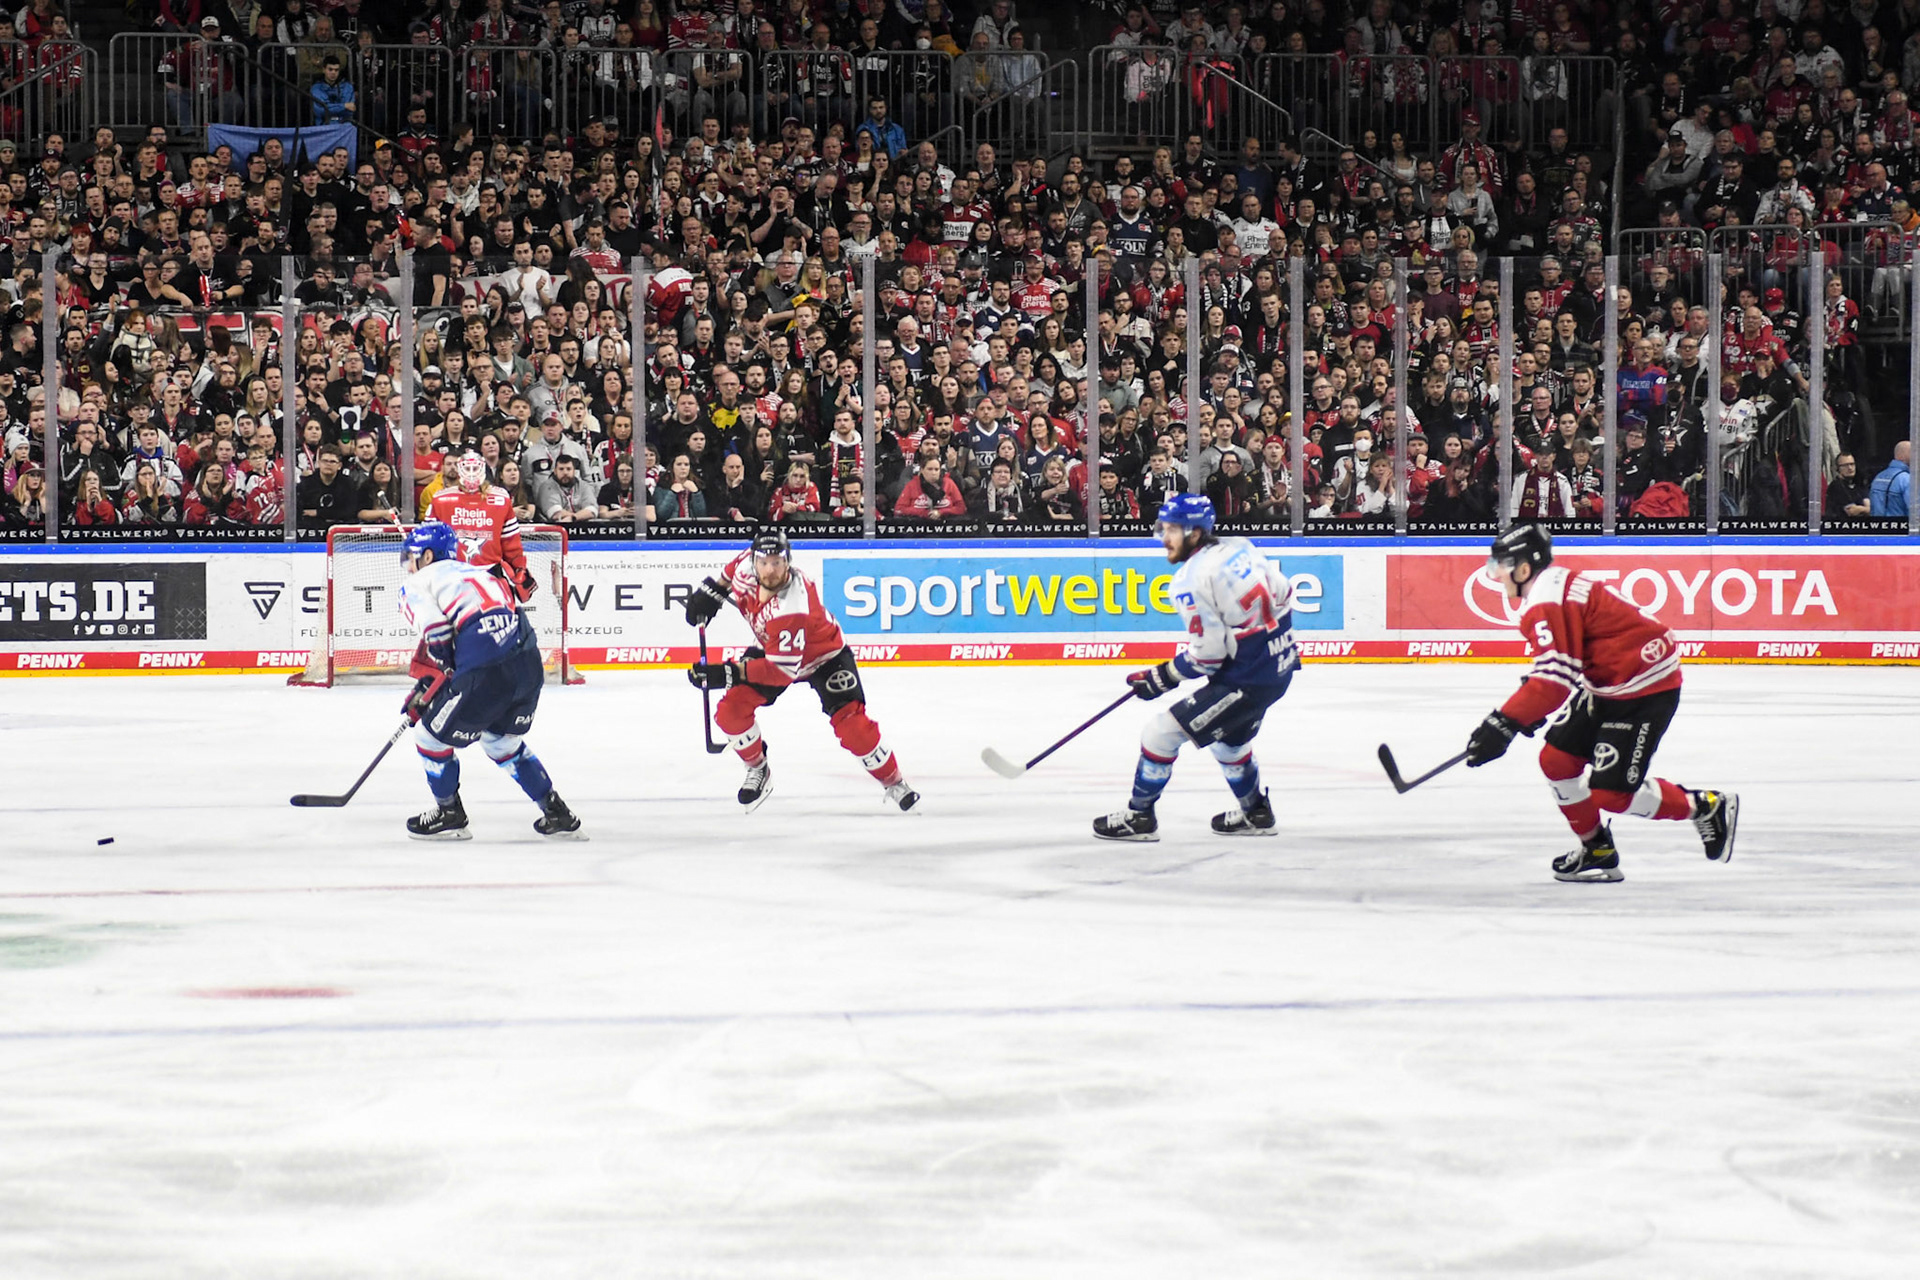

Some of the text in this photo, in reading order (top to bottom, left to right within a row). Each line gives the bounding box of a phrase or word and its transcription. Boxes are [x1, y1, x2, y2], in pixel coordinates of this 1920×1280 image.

[1023, 294, 1047, 303] Rhein
[454, 507, 487, 518] Rhein
[451, 516, 493, 527] Energie
[1307, 523, 1395, 531] STAHLWERK
[1409, 522, 1497, 530] STAHLWERK
[1618, 522, 1706, 530] STAHLWERK
[1722, 521, 1808, 529] STAHLWERK
[1823, 521, 1908, 529] STAHLWERK
[1189, 614, 1204, 638] 4
[1534, 620, 1554, 647] 5
[778, 628, 806, 652] 24
[853, 646, 901, 660] ENNY.
[1871, 643, 1920, 657] PENN
[1631, 722, 1650, 765] TOYOTA
